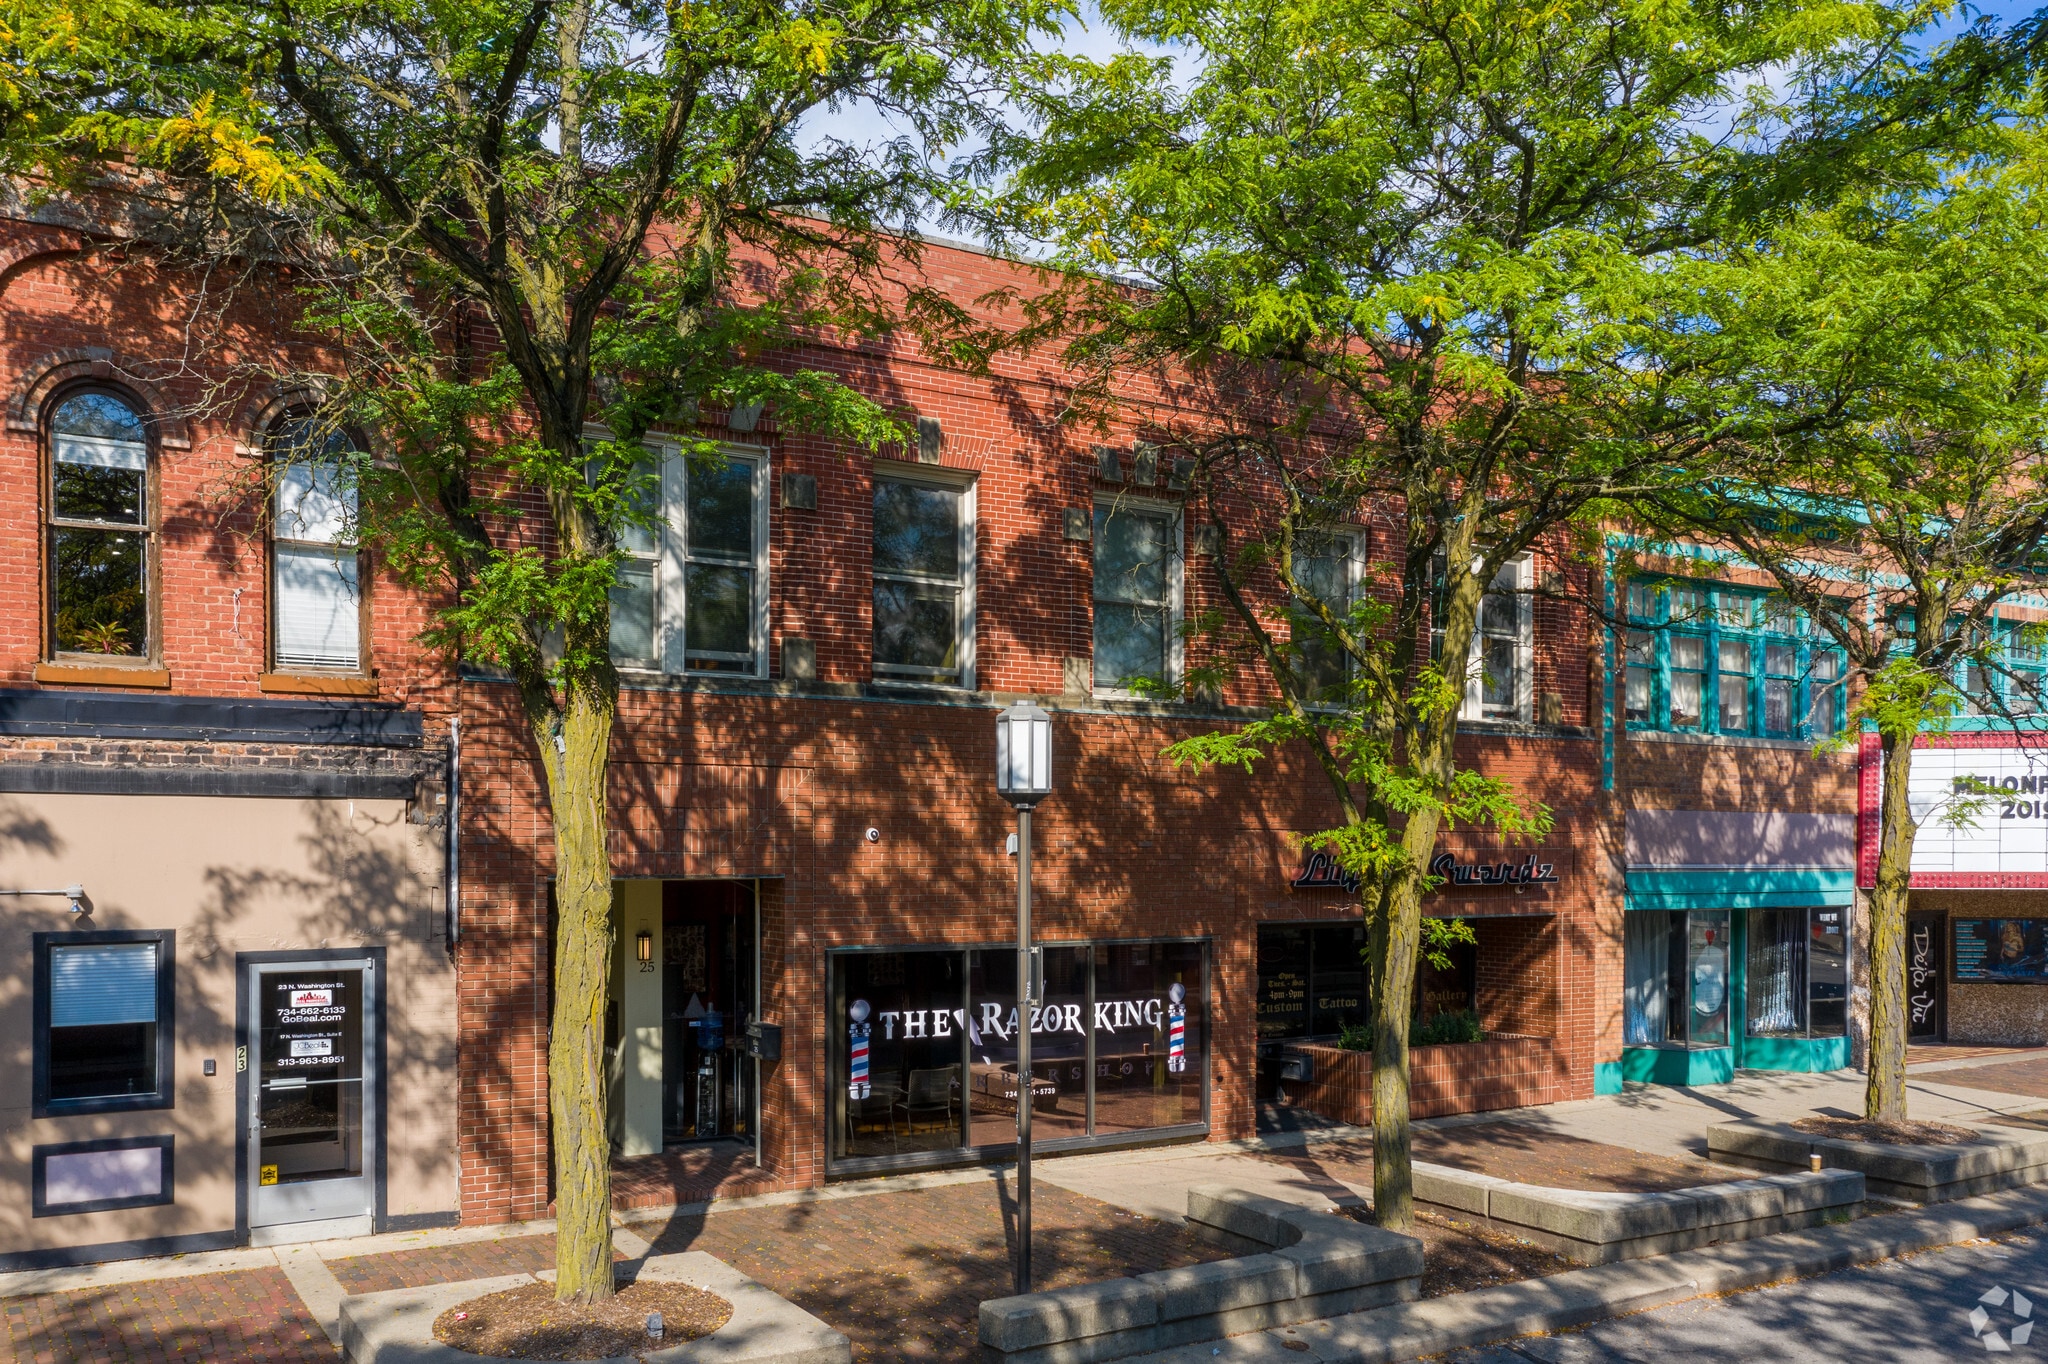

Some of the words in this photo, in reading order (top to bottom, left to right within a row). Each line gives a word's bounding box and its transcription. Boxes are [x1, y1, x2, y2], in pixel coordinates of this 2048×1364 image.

[639, 961, 655, 973] 25
[1278, 972, 1296, 980] Open
[297, 982, 335, 990] Washington
[1257, 1002, 1303, 1014] Custom
[1318, 997, 1358, 1009] Tattoo
[1425, 990, 1467, 1002] Gallery
[1910, 990, 1935, 1024] Vu
[277, 1006, 346, 1016] 734-662-6133
[282, 1014, 341, 1023] GoBeal.com
[880, 1008, 952, 1041] THE
[980, 1001, 1086, 1042] RAZOR
[1093, 998, 1164, 1034] KING
[237, 1047, 246, 1071] 23
[278, 1056, 345, 1066] 313-963-8951
